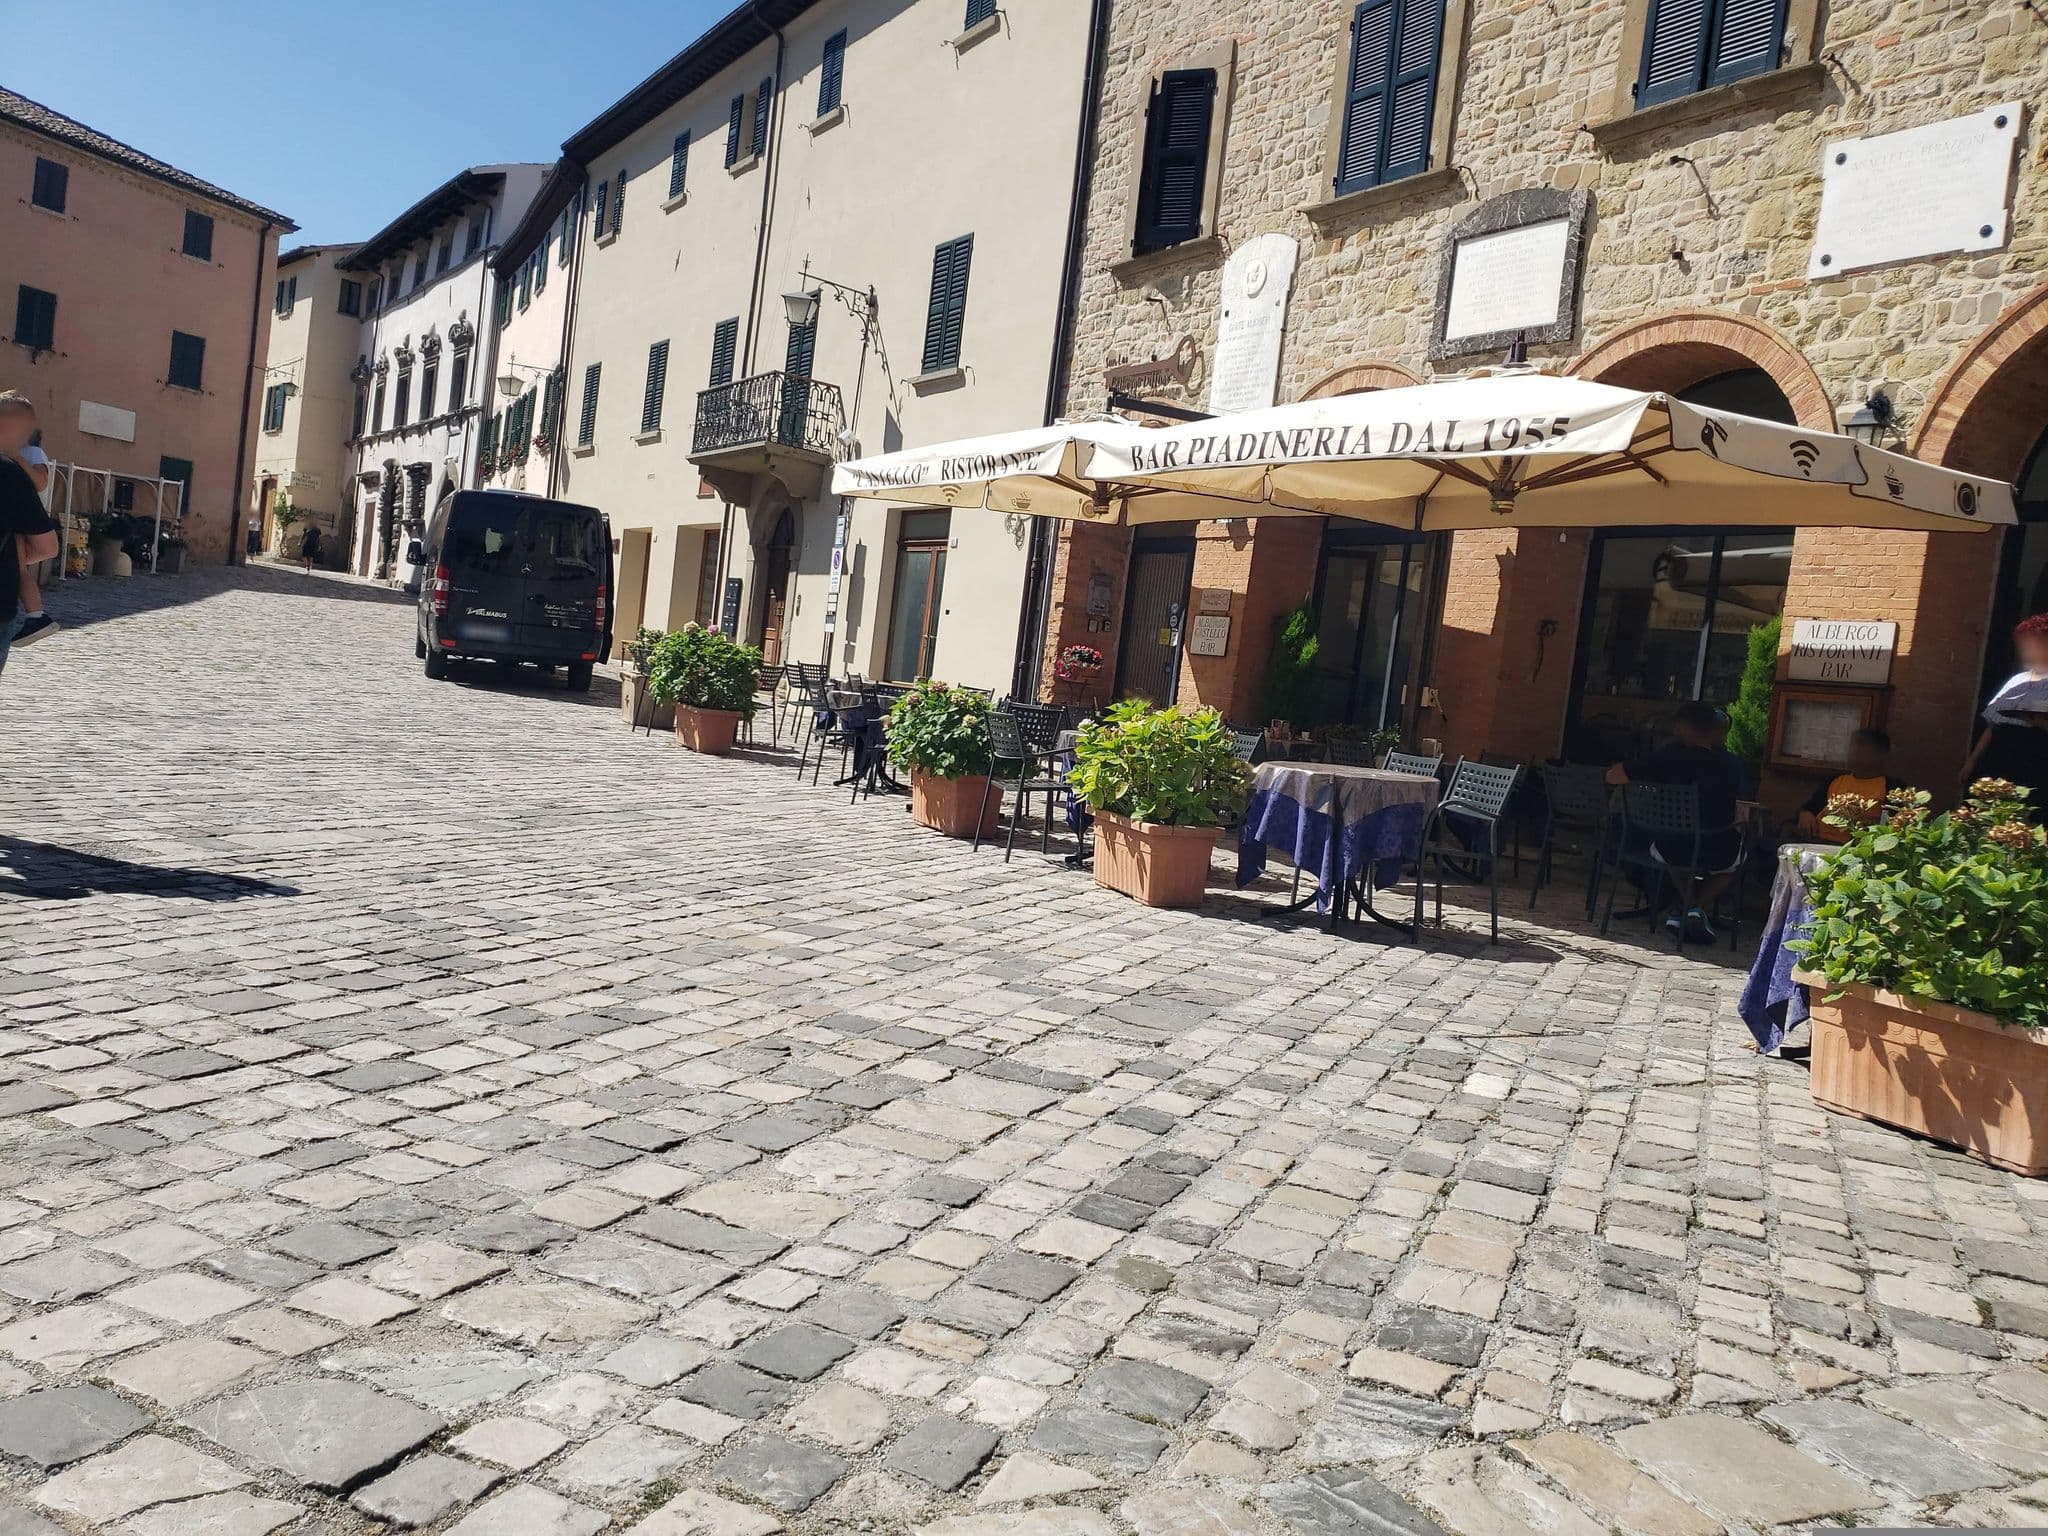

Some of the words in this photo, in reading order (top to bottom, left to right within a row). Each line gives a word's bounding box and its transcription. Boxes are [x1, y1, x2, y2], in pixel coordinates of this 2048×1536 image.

[1131, 441, 1179, 471] BAR
[1187, 425, 1370, 465] PIADINERIA
[1385, 420, 1464, 453] DAL
[1479, 417, 1570, 450] 1955
[941, 451, 1046, 481] RISTORANTE
[1806, 624, 1879, 641] ALBERGO
[1200, 641, 1216, 653] BAR
[1794, 642, 1885, 661] RISTORANTE
[1820, 661, 1853, 679] BAR
